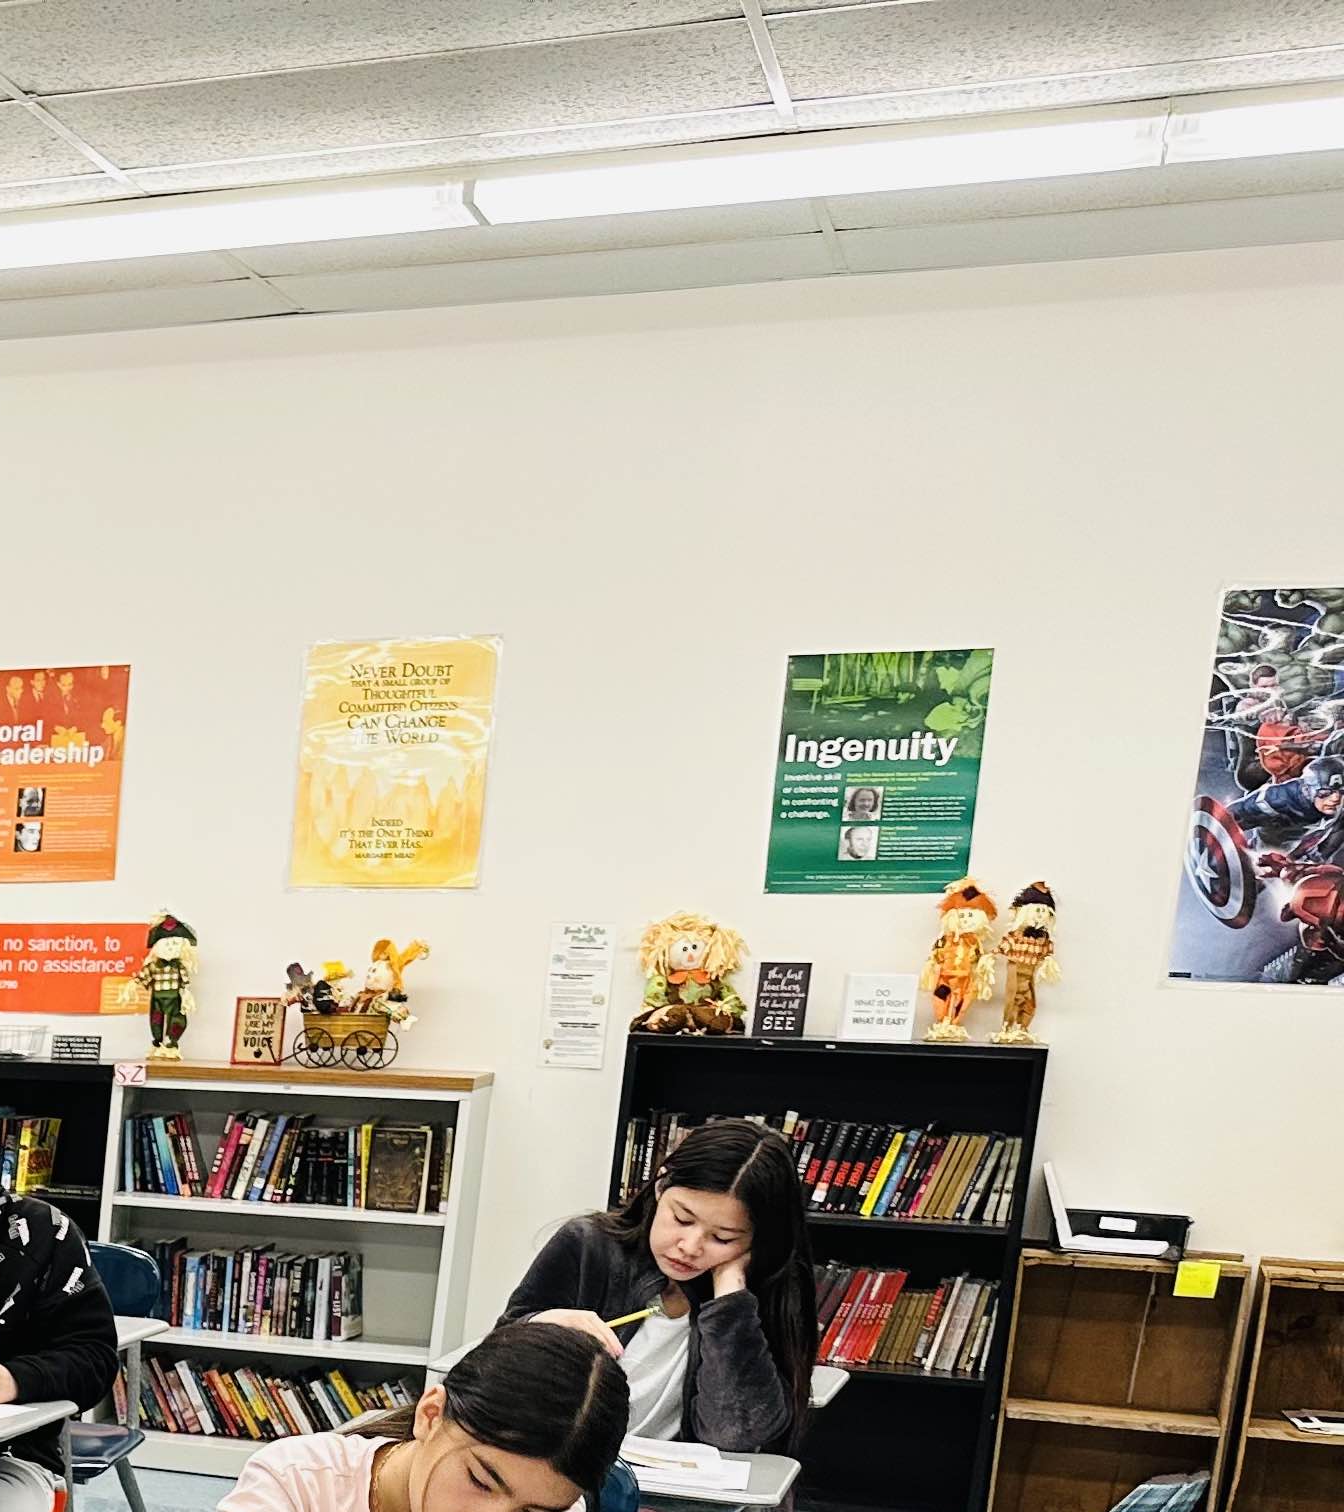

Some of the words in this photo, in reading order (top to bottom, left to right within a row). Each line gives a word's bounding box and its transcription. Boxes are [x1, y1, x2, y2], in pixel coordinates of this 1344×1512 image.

[351, 664, 396, 679] NEVER
[402, 662, 454, 677] DOUBT
[383, 679, 408, 687] SMALL
[362, 688, 437, 701] THOUGHTFUL
[339, 701, 407, 713] COMMITTED
[410, 700, 459, 712] CITIZENS
[348, 714, 381, 729] CAN
[385, 714, 447, 728] CHANGE
[384, 730, 439, 744] WORLD
[784, 731, 959, 768] Ingenuity
[372, 817, 403, 827] INDEED
[376, 828, 402, 838] ONLY
[348, 839, 372, 849] THAT
[375, 839, 399, 849] EVER
[3, 938, 24, 951] no
[27, 936, 98, 954] sanction,
[104, 937, 121, 951] to
[18, 959, 38, 972] no
[875, 989, 891, 997] DO
[247, 1002, 278, 1014] DON'T
[762, 1016, 796, 1031] SEE
[852, 1017, 874, 1025] WHAT
[886, 1017, 908, 1026] EASY
[243, 1036, 273, 1047] VOICE
